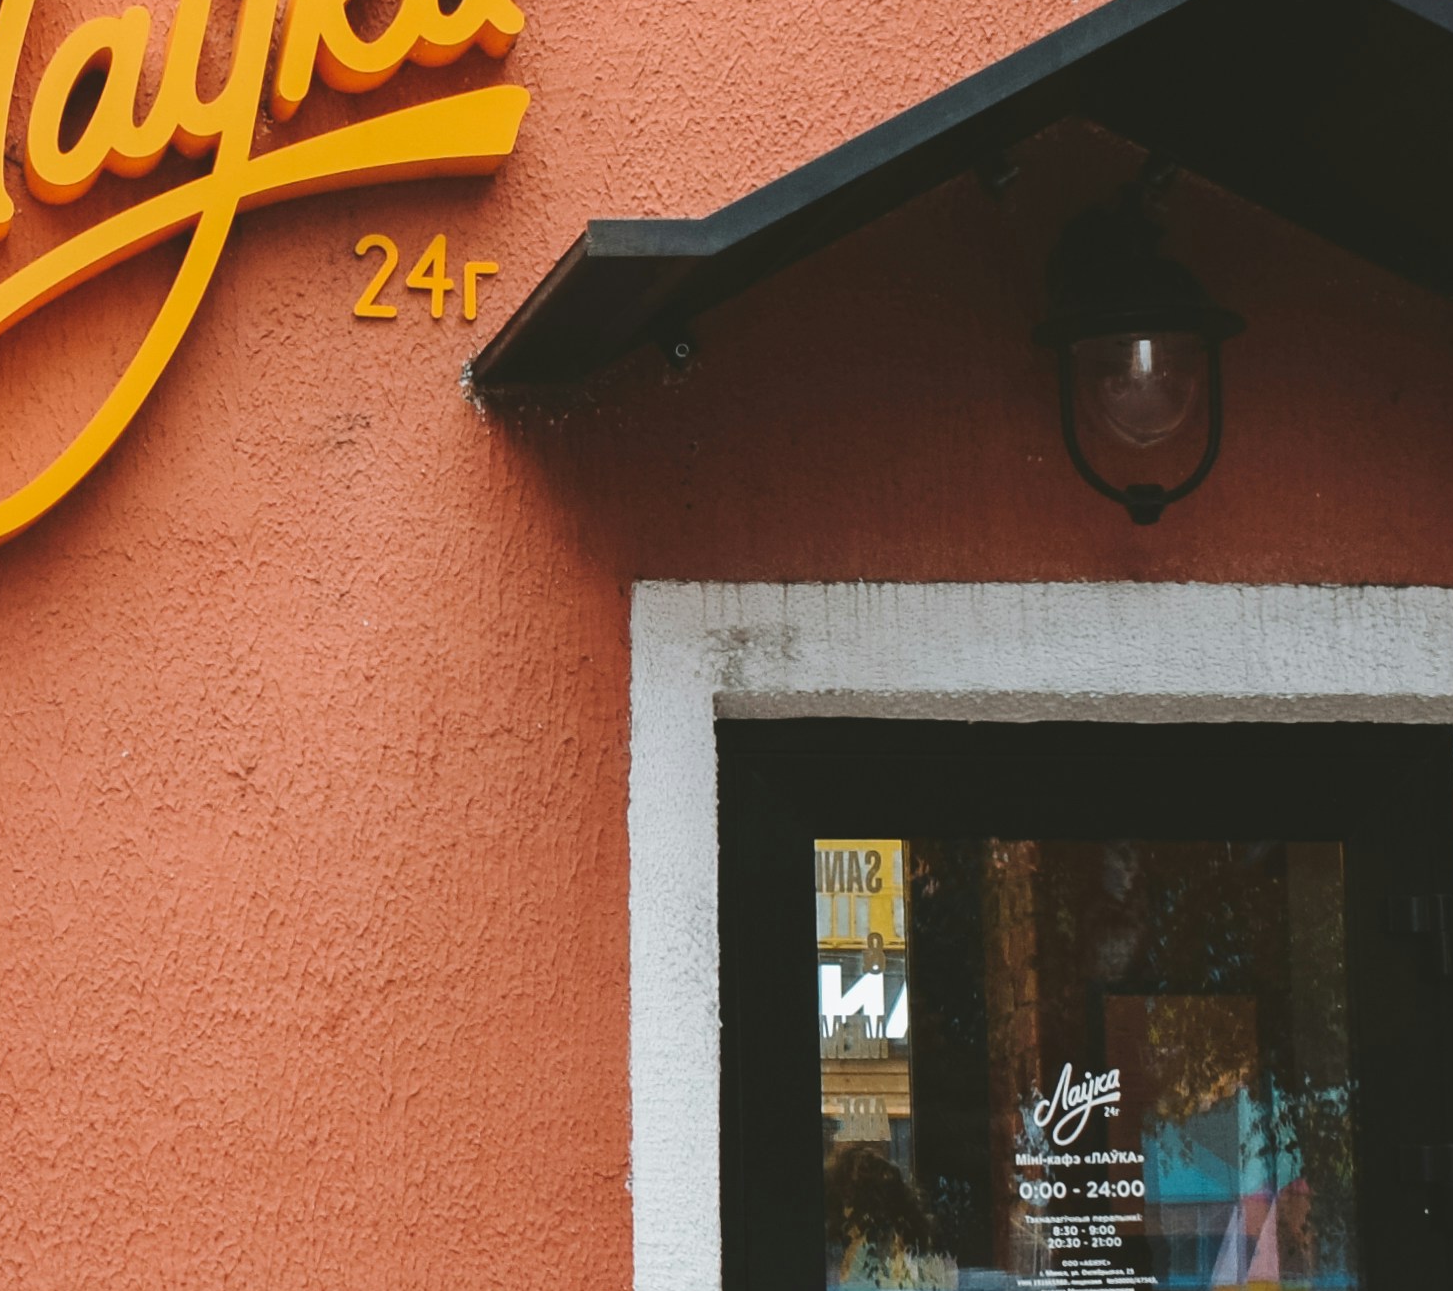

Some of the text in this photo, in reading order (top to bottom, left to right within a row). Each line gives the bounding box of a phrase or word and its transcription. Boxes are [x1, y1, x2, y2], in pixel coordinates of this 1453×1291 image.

[354, 234, 499, 321] 24г
[1019, 1181, 1067, 1199] 0:00
[1086, 1179, 1145, 1198] 24:00
[1053, 1226, 1078, 1236] 8:30
[1089, 1225, 1116, 1236] 9:00
[1048, 1238, 1081, 1249] 20:30
[1091, 1237, 1122, 1247] 21:00
